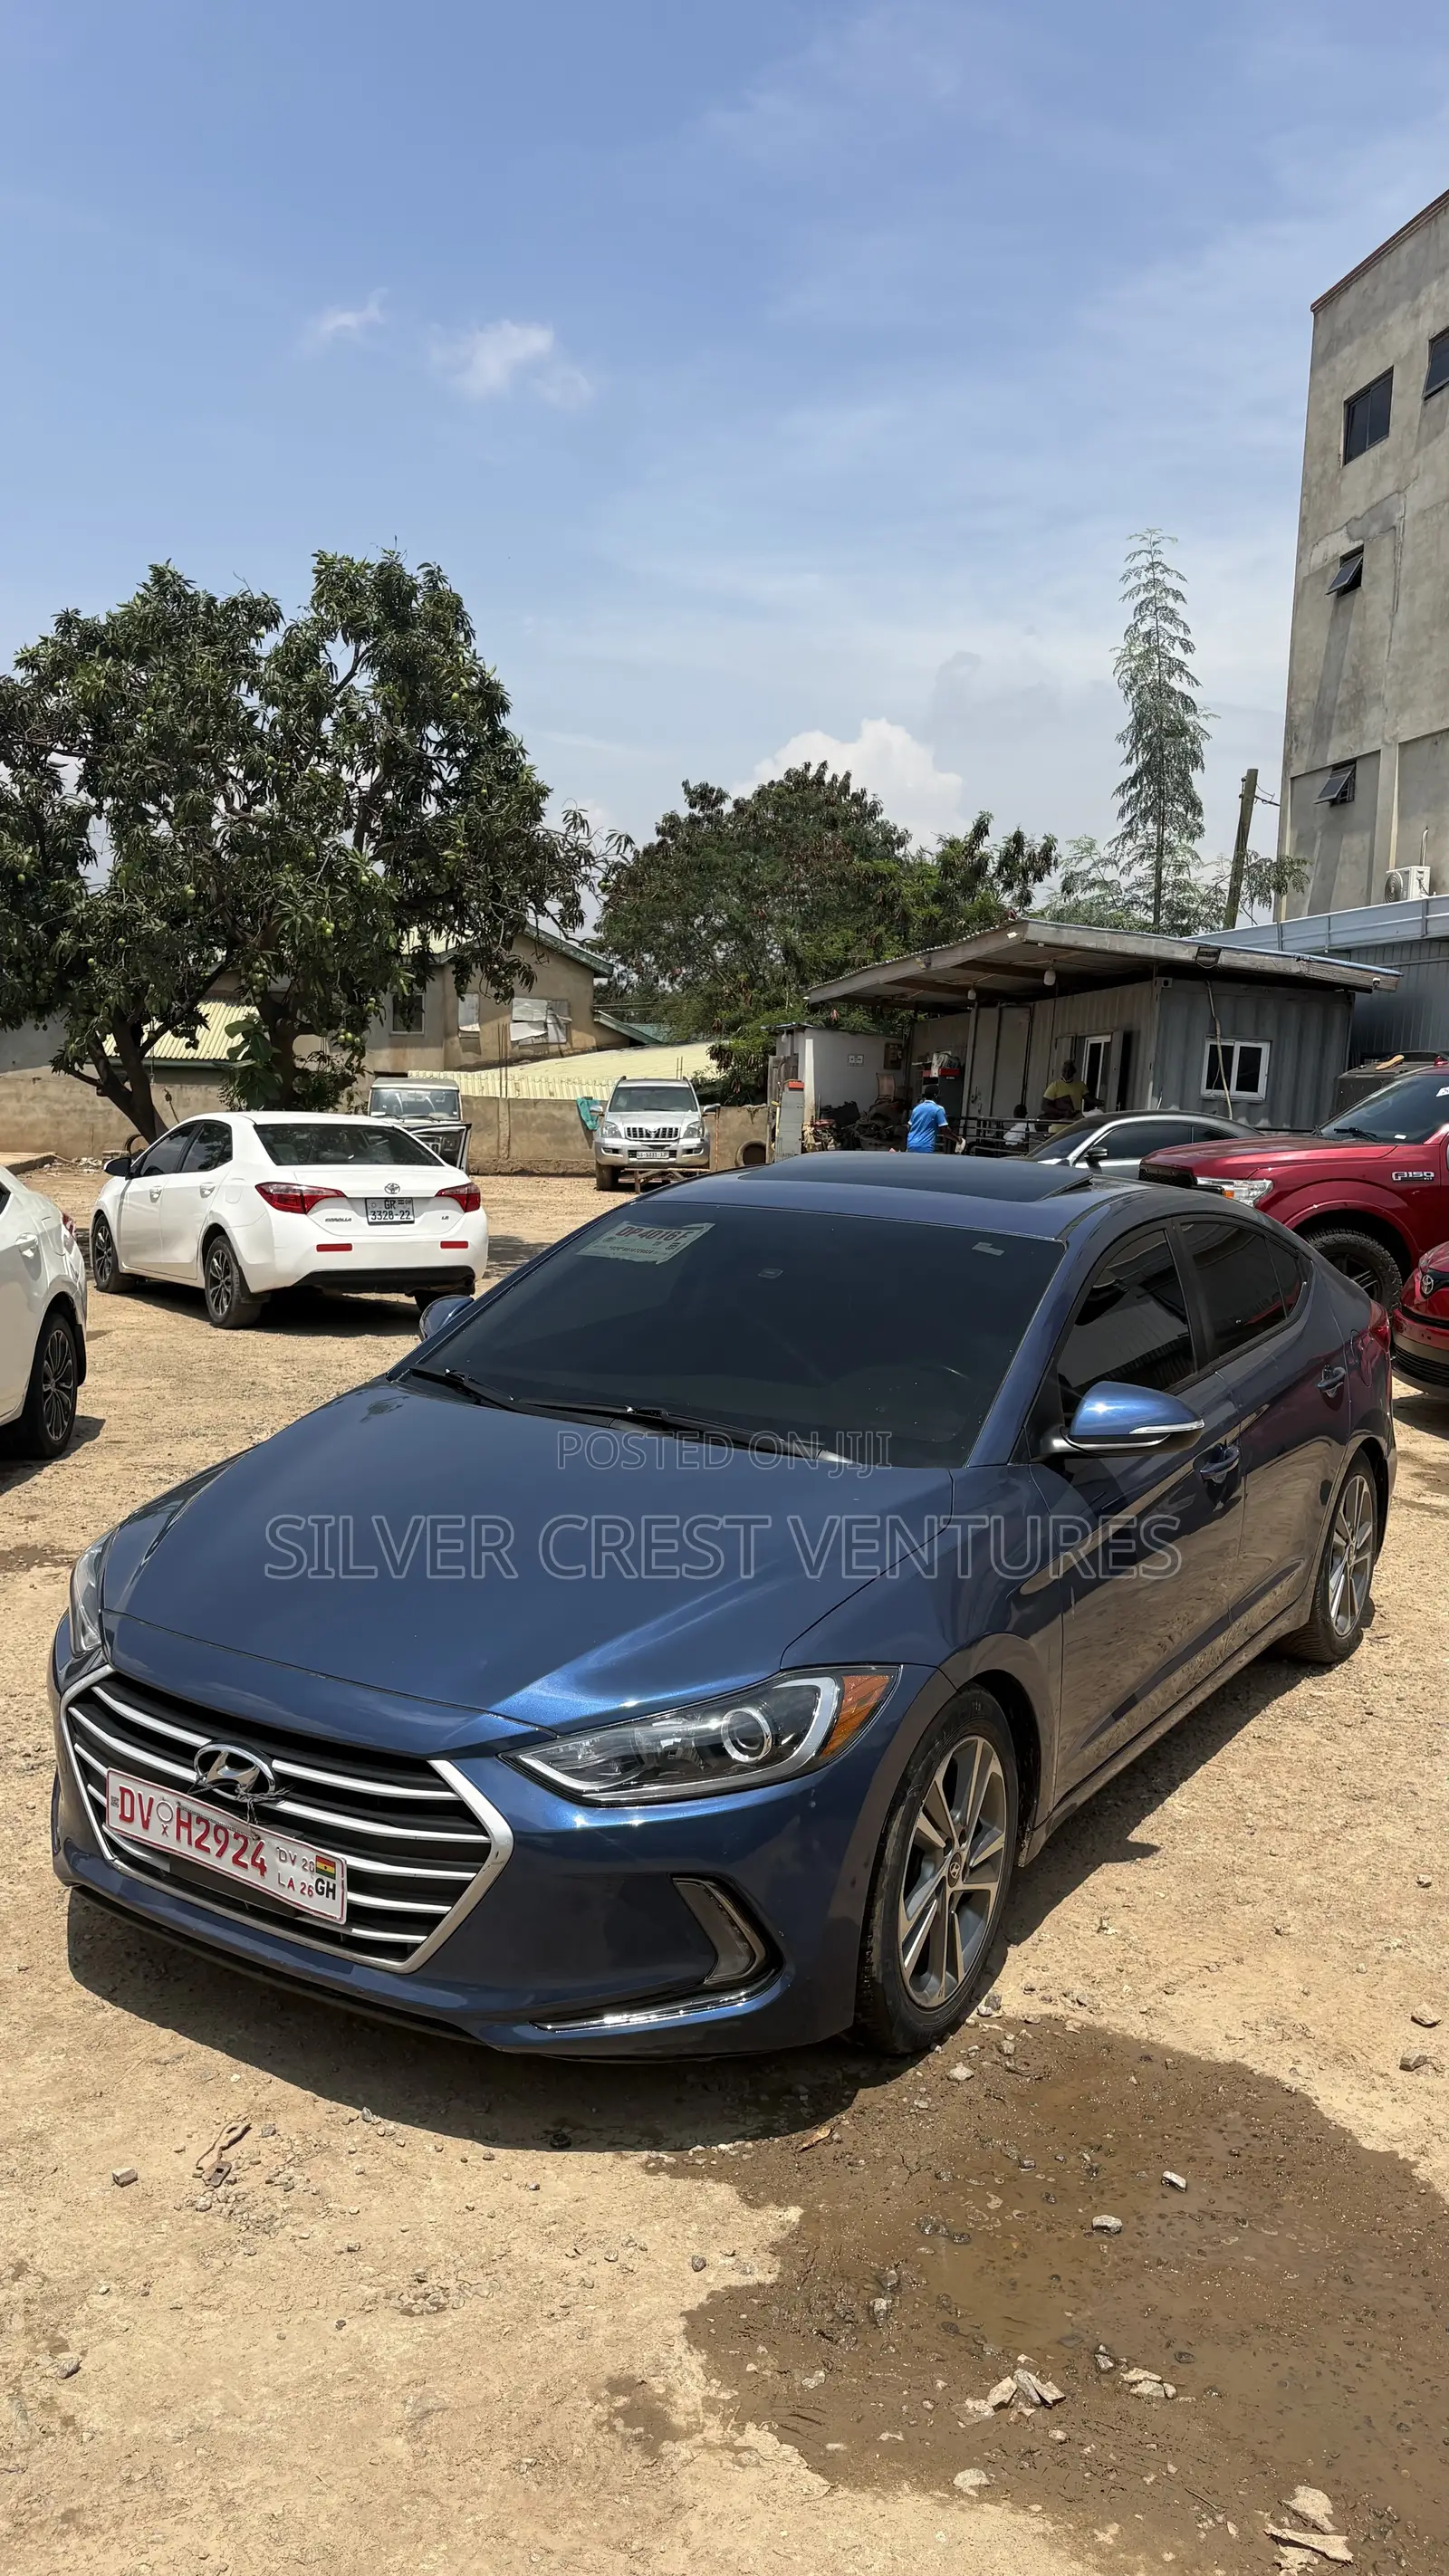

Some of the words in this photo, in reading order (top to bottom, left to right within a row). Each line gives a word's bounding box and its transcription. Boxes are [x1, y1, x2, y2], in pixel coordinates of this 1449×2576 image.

[370, 1210, 411, 1221] 3328-22
[384, 1199, 396, 1210] GR
[119, 1786, 154, 1831] DV
[175, 1806, 267, 1878] H2924
[278, 1847, 297, 1866] DV
[302, 1858, 315, 1873] 20
[278, 1872, 295, 1891] LA
[300, 1882, 314, 1898] 26
[314, 1877, 336, 1901] GH
